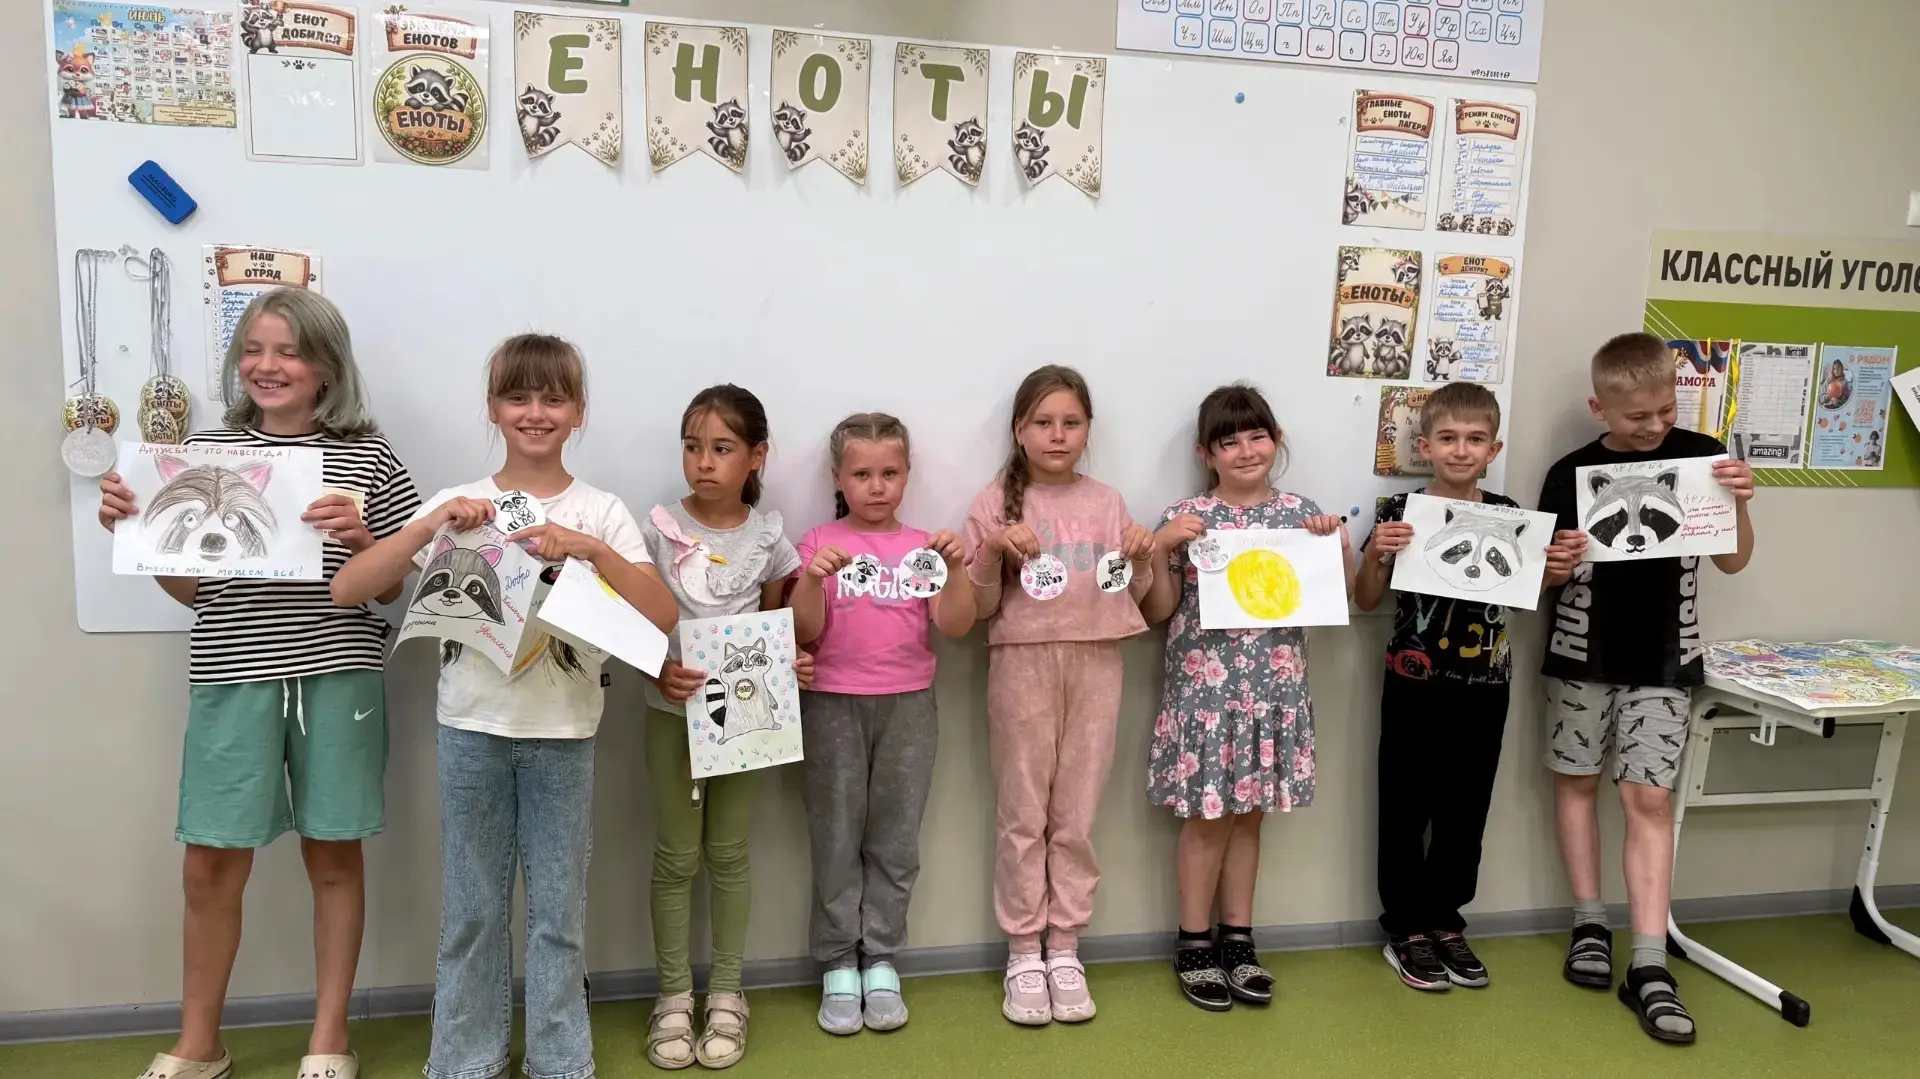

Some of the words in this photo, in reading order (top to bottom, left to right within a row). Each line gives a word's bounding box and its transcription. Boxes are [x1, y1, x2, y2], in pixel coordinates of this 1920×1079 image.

[128, 9, 167, 23] ИЮНЬ
[294, 13, 328, 28] ЕНОТ
[1249, 1, 1263, 14] Оо
[1279, 2, 1300, 18] Пп
[1312, 5, 1331, 26] Рр
[1347, 9, 1361, 24] Сс
[1375, 11, 1396, 27] Тт
[1408, 13, 1425, 35] Уу
[1437, 17, 1457, 37] Фф
[1469, 21, 1487, 36] Хх
[403, 33, 459, 49] ЕНОТОВ
[1212, 29, 1233, 43] Шш
[1244, 31, 1264, 49] Щщ
[1377, 43, 1391, 58] Ээ
[1405, 46, 1424, 61] Юю
[1437, 50, 1453, 64] Яя
[1365, 99, 1402, 109] ГЛАВНЫЕ
[398, 110, 465, 133] ЕНОТЫ
[1383, 111, 1411, 119] ЕНОТЫ
[1464, 111, 1488, 119] РЕЖИМ
[1490, 111, 1516, 125] ЕНОТОВ
[1398, 119, 1427, 132] ЛАГЕРЯ
[250, 252, 275, 261] НАШ
[1464, 257, 1486, 265] ЕНОТ
[244, 268, 282, 280] ОТРЯД
[1461, 266, 1488, 274] ДЕЖУРИТ
[1661, 248, 1834, 289] КЛАССНЫЙ
[1351, 285, 1405, 304] ЕНОТЫ
[1857, 355, 1891, 365] РЯДОМ
[1676, 377, 1716, 387] АМОТА
[149, 433, 173, 441] ЕНОТЫ
[1752, 447, 1785, 457] amazing!
[505, 566, 530, 590] Добро
